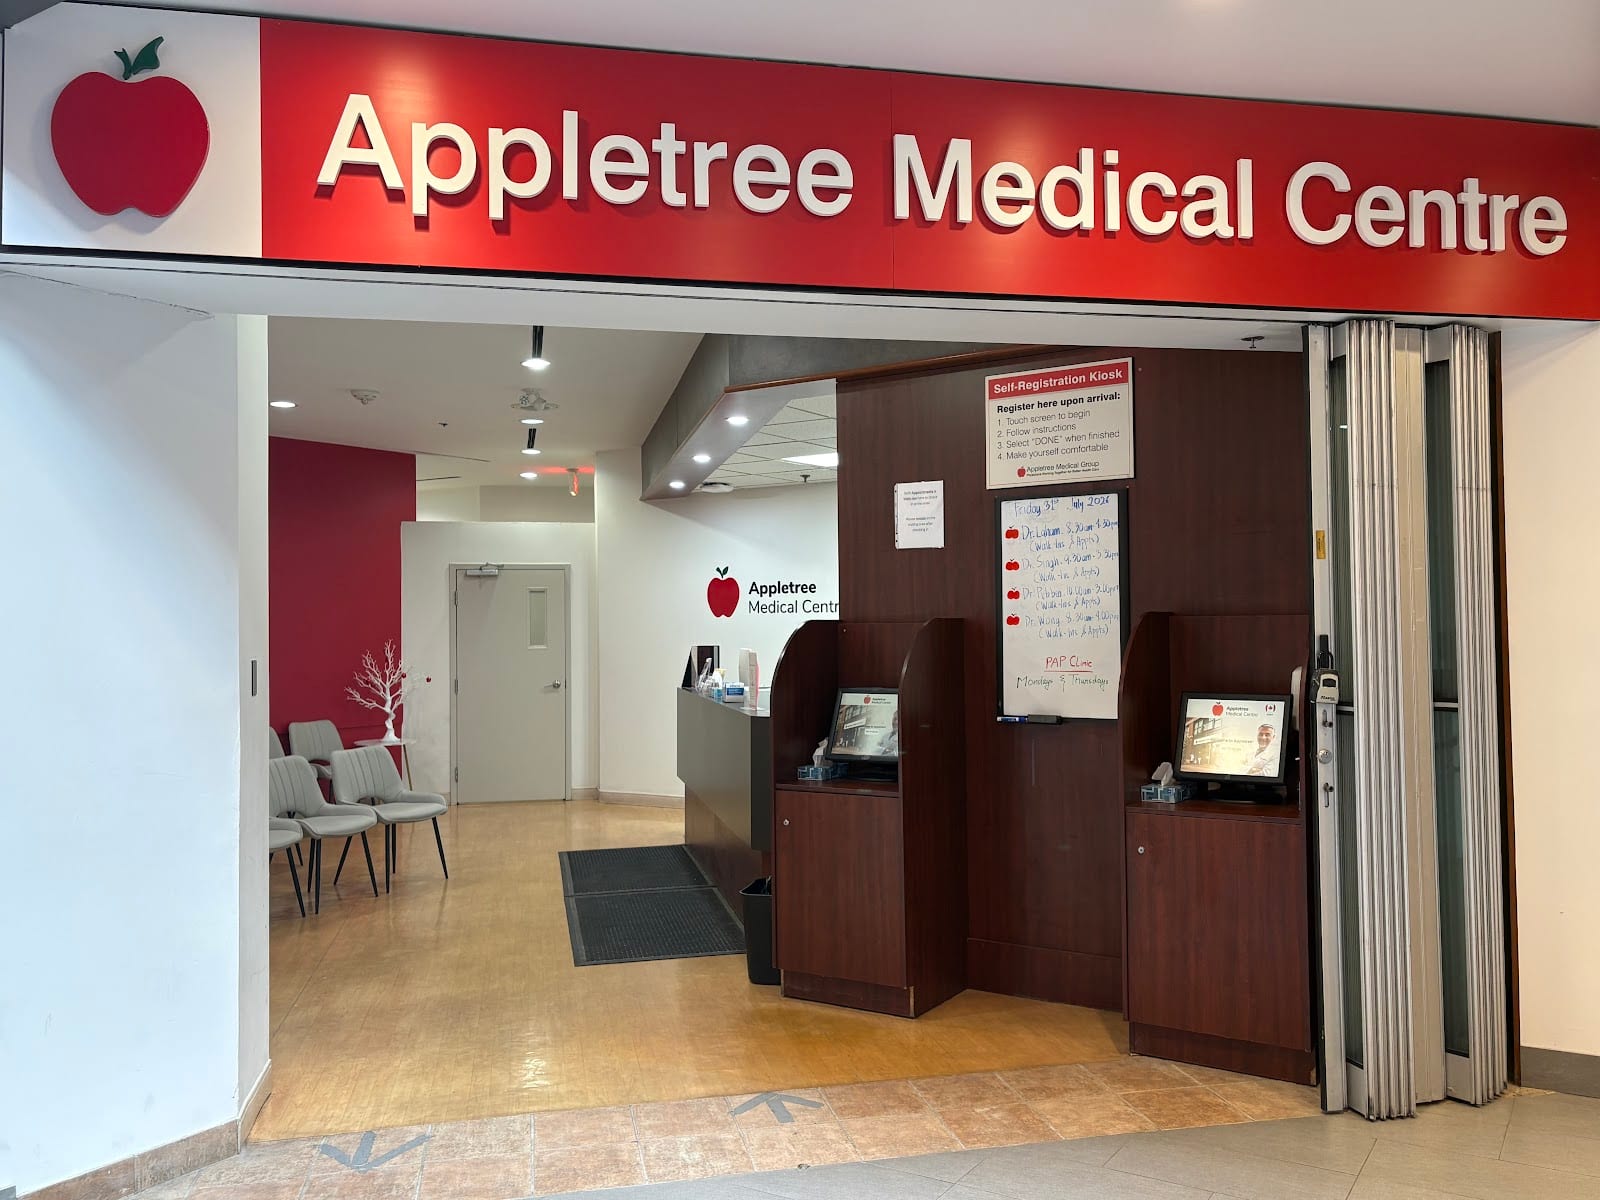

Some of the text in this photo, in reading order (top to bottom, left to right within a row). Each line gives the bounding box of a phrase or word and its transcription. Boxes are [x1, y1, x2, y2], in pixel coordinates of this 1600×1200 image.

[317, 94, 1568, 257] Appletree Medical Centre
[993, 368, 1123, 394] Self-Registration Kiosk
[997, 392, 1121, 415] Register here upon arrival:
[997, 408, 1091, 427] 1. Touch screen to begin
[997, 423, 1077, 438] 2. Follow instructions
[997, 429, 1120, 450] 3. Select "DONE" when finished
[997, 442, 1109, 461] 4. Make yourself comfortable
[1027, 461, 1100, 473] Appletree Medical Group
[1014, 501, 1041, 517] Friday
[1071, 496, 1084, 512] July
[1021, 524, 1035, 540] Dr.
[748, 580, 817, 598] Appletree
[748, 600, 798, 614] Medical
[1045, 656, 1067, 669] PAP
